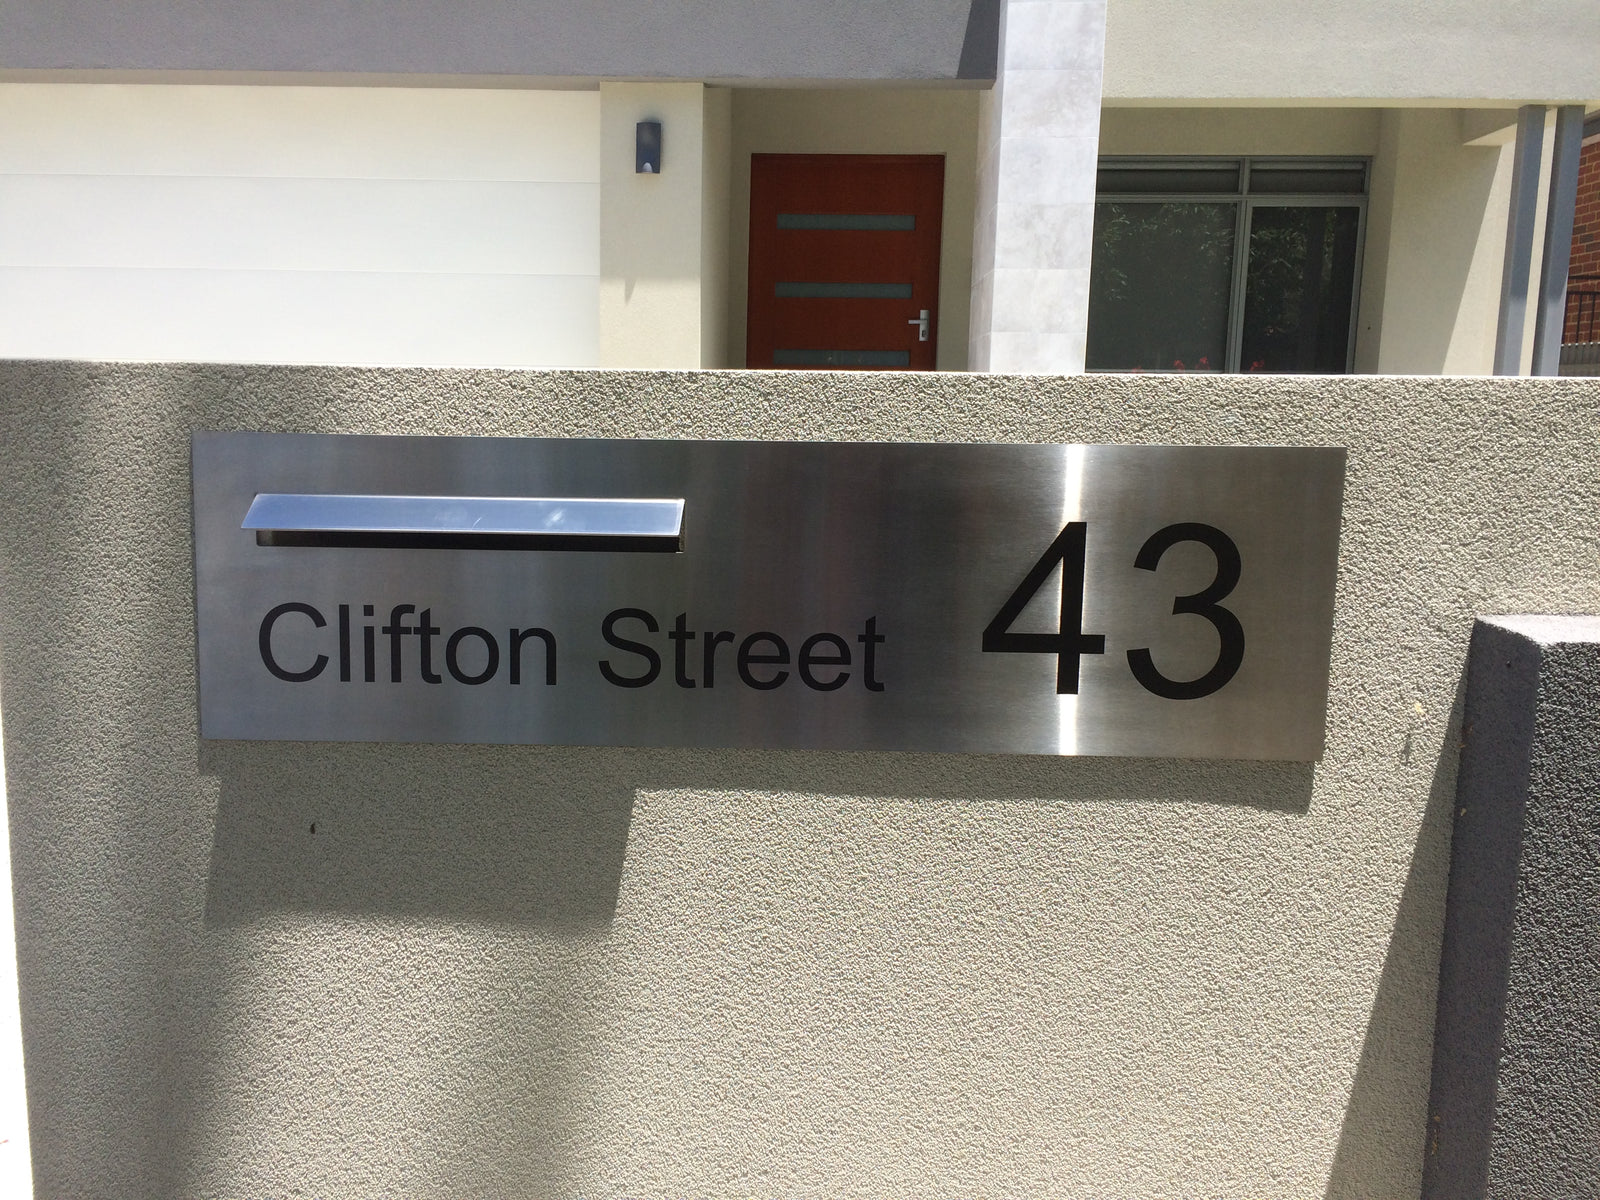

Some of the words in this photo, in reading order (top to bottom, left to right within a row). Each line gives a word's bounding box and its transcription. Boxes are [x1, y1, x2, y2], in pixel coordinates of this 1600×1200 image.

[258, 602, 558, 686] Clifton
[598, 607, 886, 692] Street
[981, 521, 1246, 701] 43
